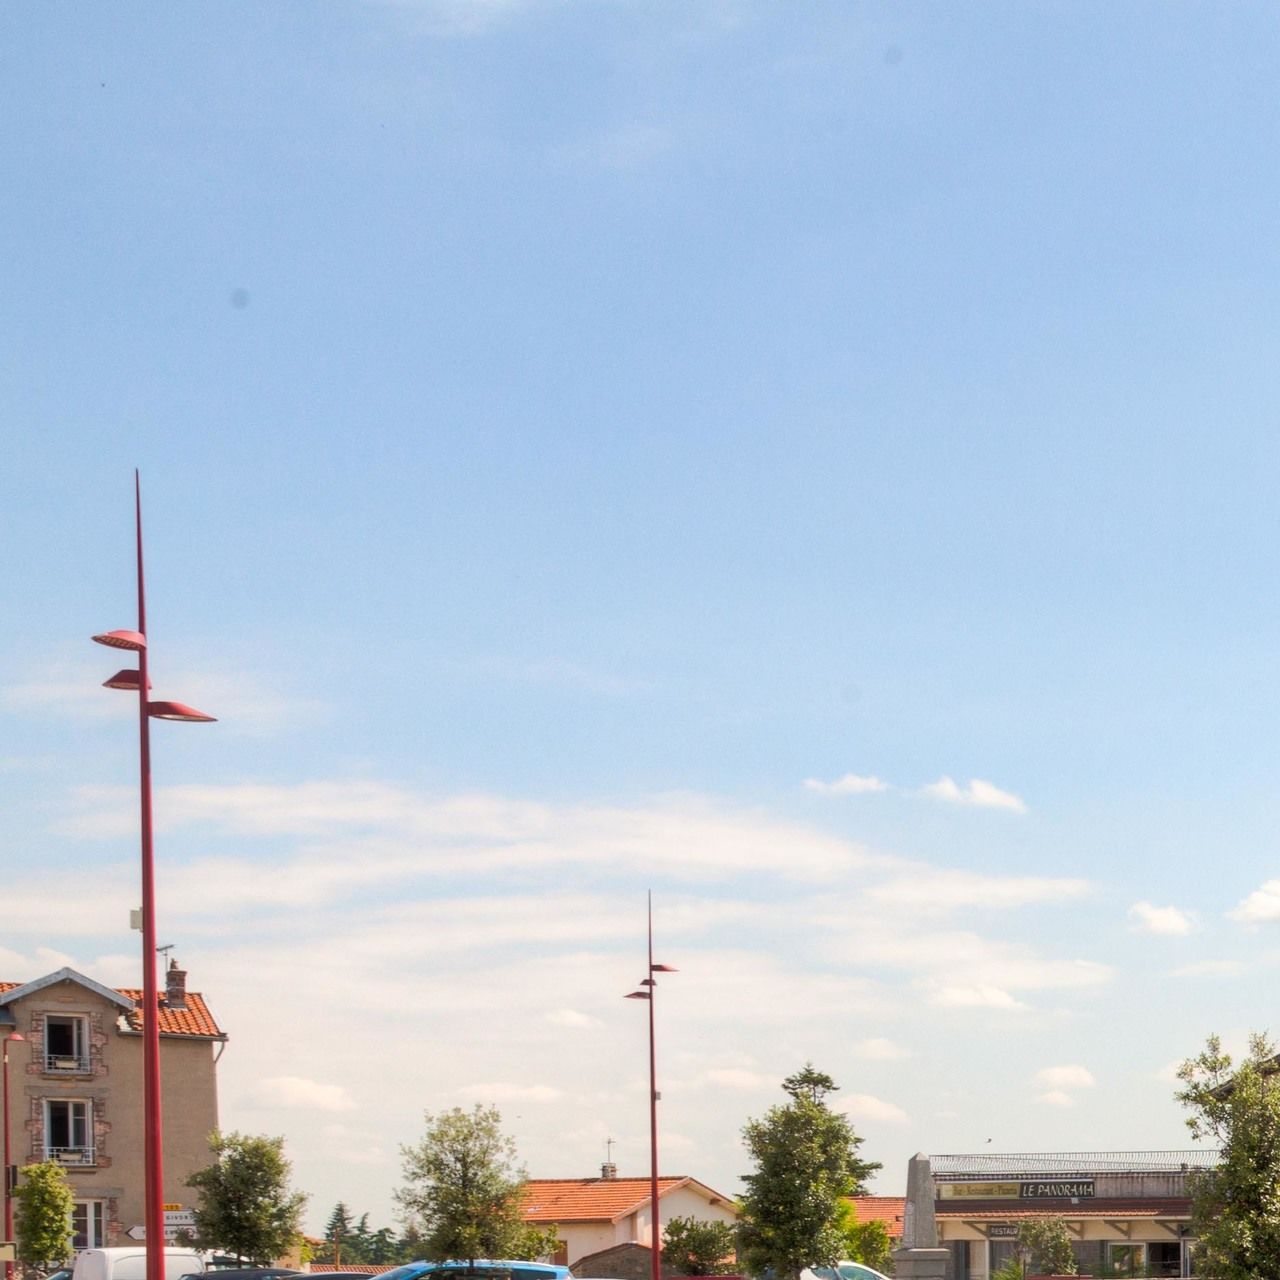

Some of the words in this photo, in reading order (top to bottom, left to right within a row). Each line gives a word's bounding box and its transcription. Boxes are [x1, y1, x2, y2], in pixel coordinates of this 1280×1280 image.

[1023, 1184, 1035, 1197] LE
[1038, 1184, 1094, 1197] PANORAMA
[991, 1227, 1018, 1235] RESTAUR
